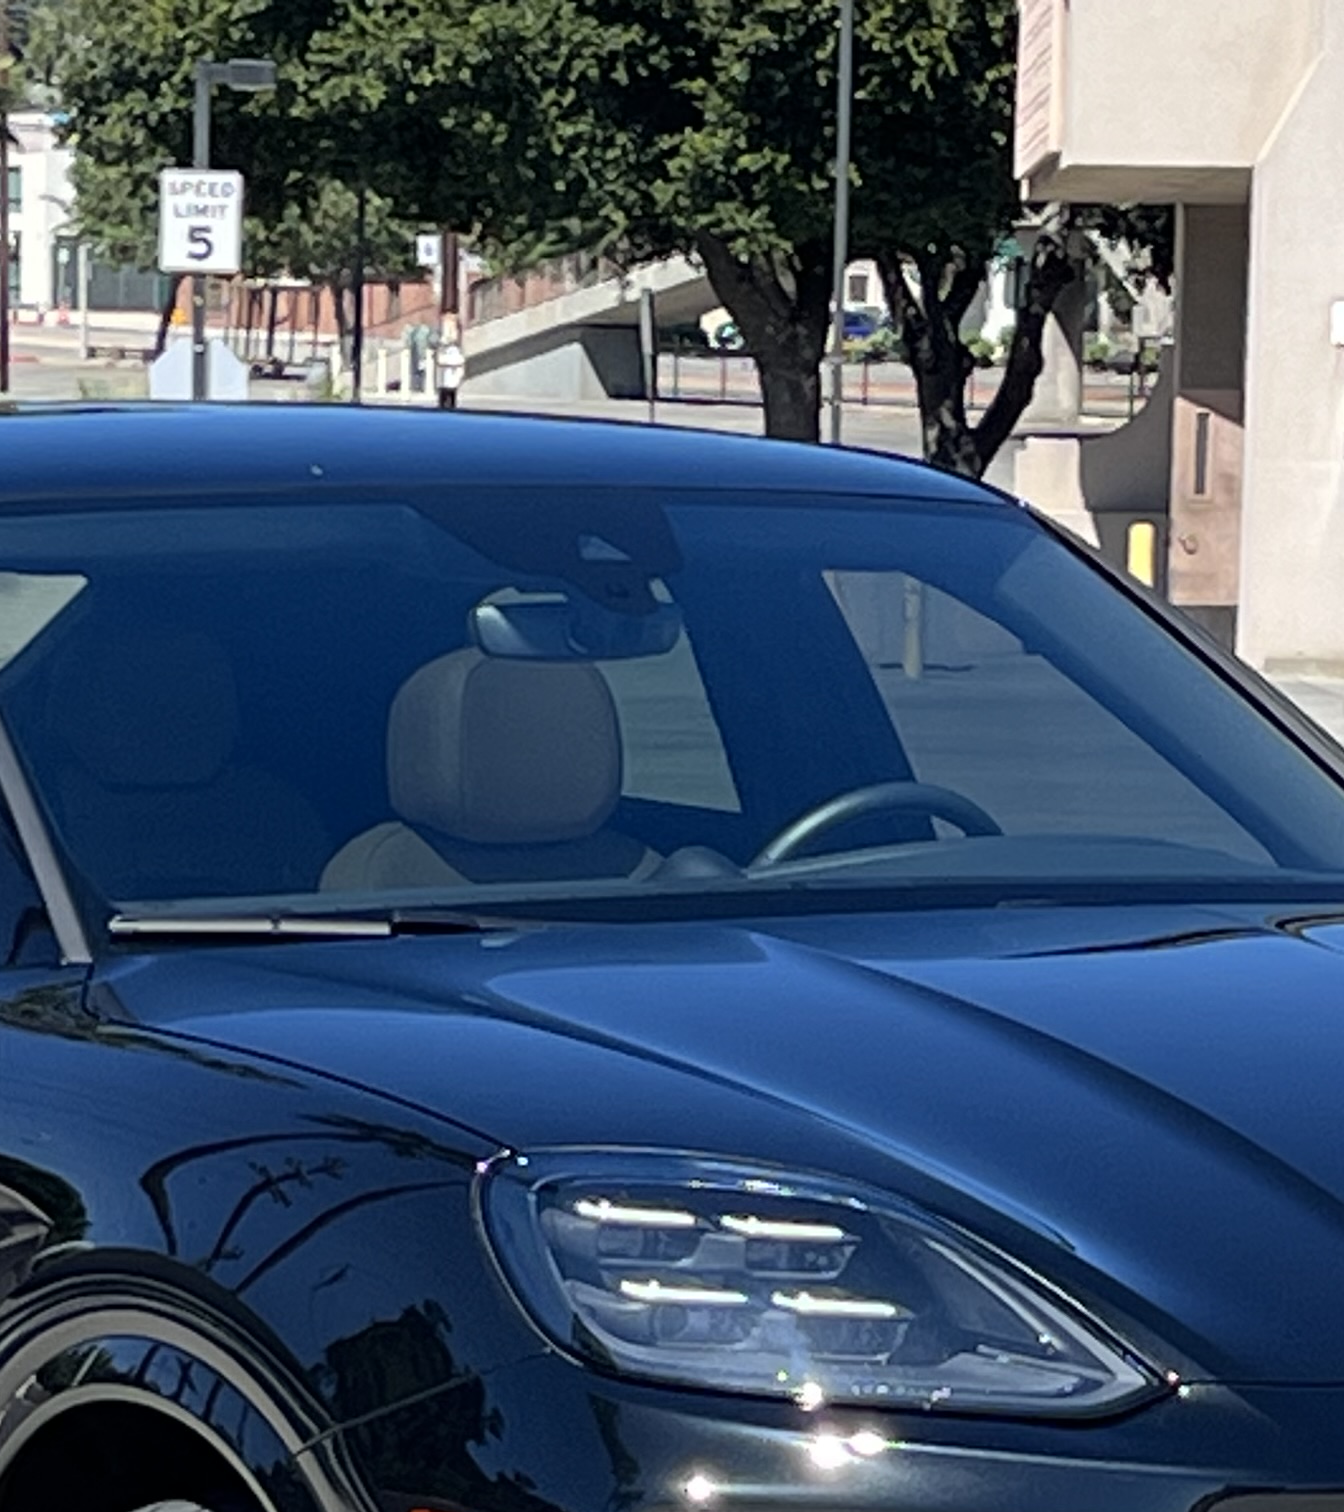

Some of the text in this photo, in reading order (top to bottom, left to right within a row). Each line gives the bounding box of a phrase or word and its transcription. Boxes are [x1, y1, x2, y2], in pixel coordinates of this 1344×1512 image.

[168, 180, 235, 198] SPEED
[173, 203, 229, 218] LIMIT
[187, 226, 214, 261] 5
